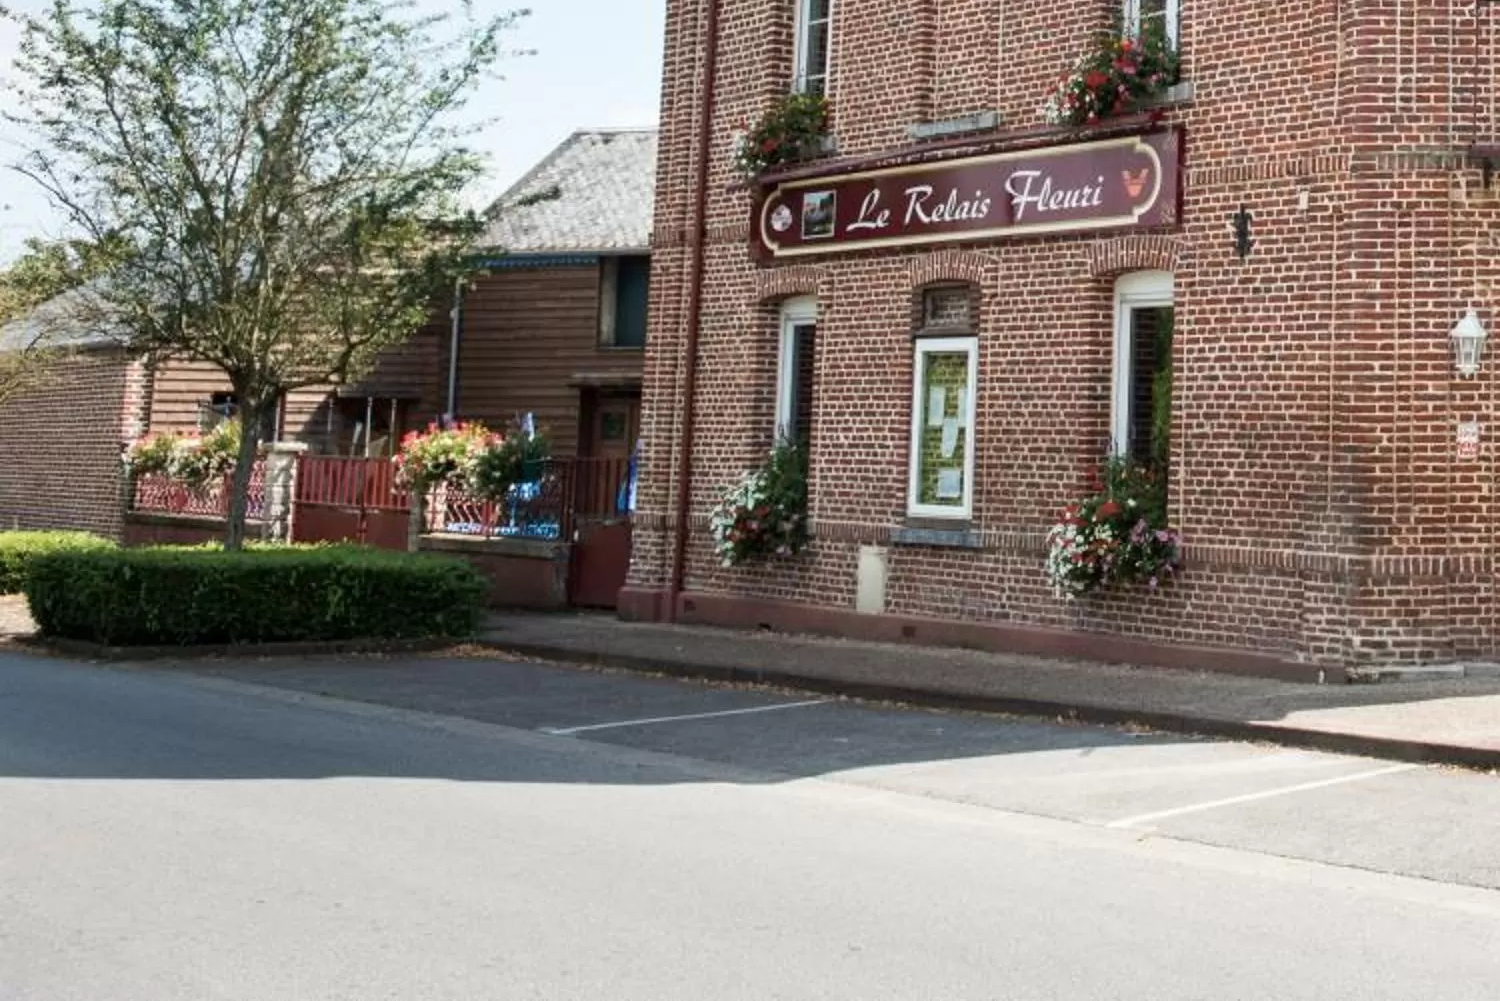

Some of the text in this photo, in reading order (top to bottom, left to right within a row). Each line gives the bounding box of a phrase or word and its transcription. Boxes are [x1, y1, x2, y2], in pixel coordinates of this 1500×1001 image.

[846, 169, 1105, 232] Le Relais Fleuri
